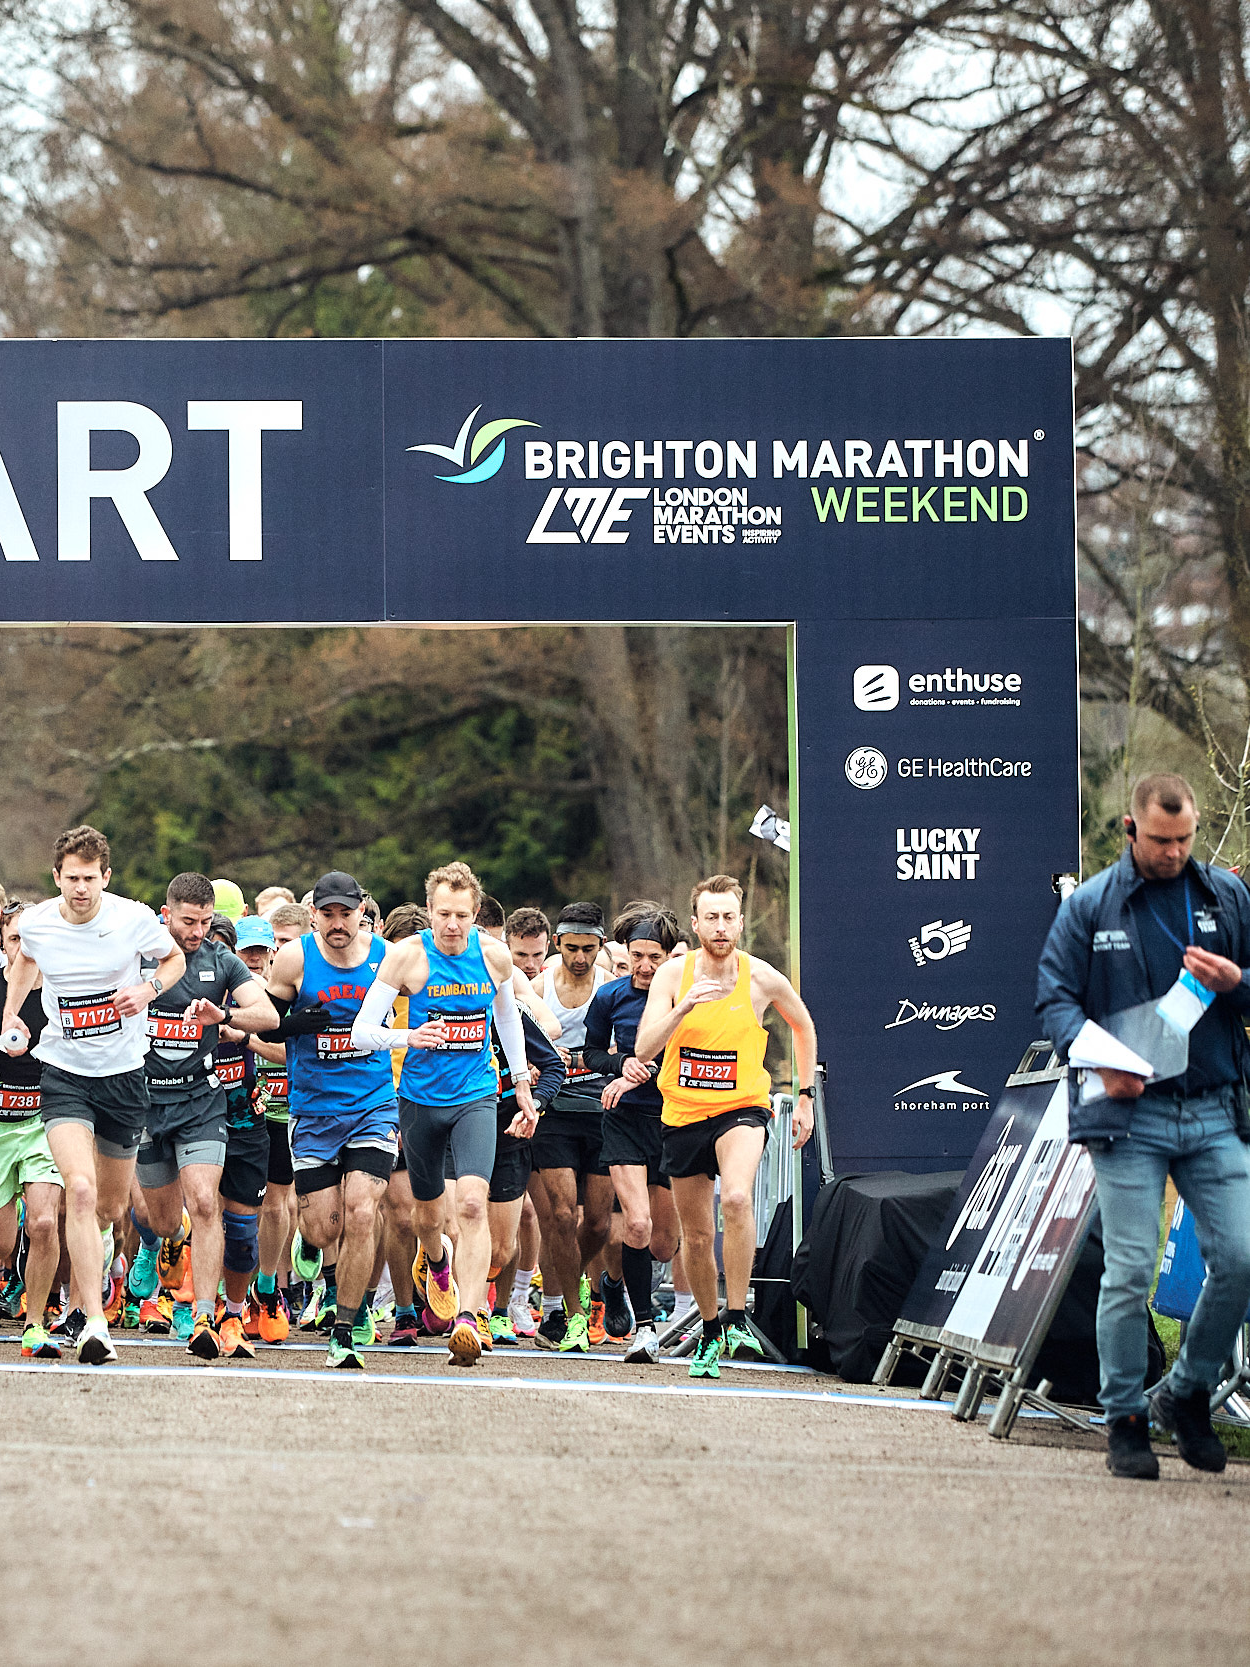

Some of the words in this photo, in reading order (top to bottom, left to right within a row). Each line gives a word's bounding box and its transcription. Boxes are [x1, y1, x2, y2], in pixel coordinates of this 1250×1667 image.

[524, 440, 757, 480] BRIGHTON
[653, 487, 748, 507] LONDON
[810, 486, 1029, 523] WEEKEND
[653, 506, 782, 525] MARATHON
[653, 525, 736, 544] EVENTS
[742, 529, 782, 537] INSPIRING
[742, 536, 778, 544] ACTIVITY
[908, 667, 1022, 692] enthuse
[910, 698, 946, 706] donations
[981, 698, 1021, 707] fundraising
[897, 758, 924, 777] GE
[928, 757, 1032, 777] HealthCare
[896, 828, 981, 852] LUCKY
[896, 853, 980, 880] SAINT
[908, 937, 927, 967] HIGH
[317, 984, 367, 1004] AREN
[480, 981, 492, 995] AC
[78, 1007, 116, 1026] 7172
[884, 998, 997, 1031] Dinnages
[163, 1023, 198, 1038] 7193
[444, 1024, 484, 1040] 17065
[321, 1041, 328, 1049] G
[696, 1063, 732, 1079] 7527
[267, 1082, 284, 1095] 77
[9, 1095, 41, 1107] 7381
[894, 1101, 957, 1111] shoreham
[962, 1101, 990, 1112] port
